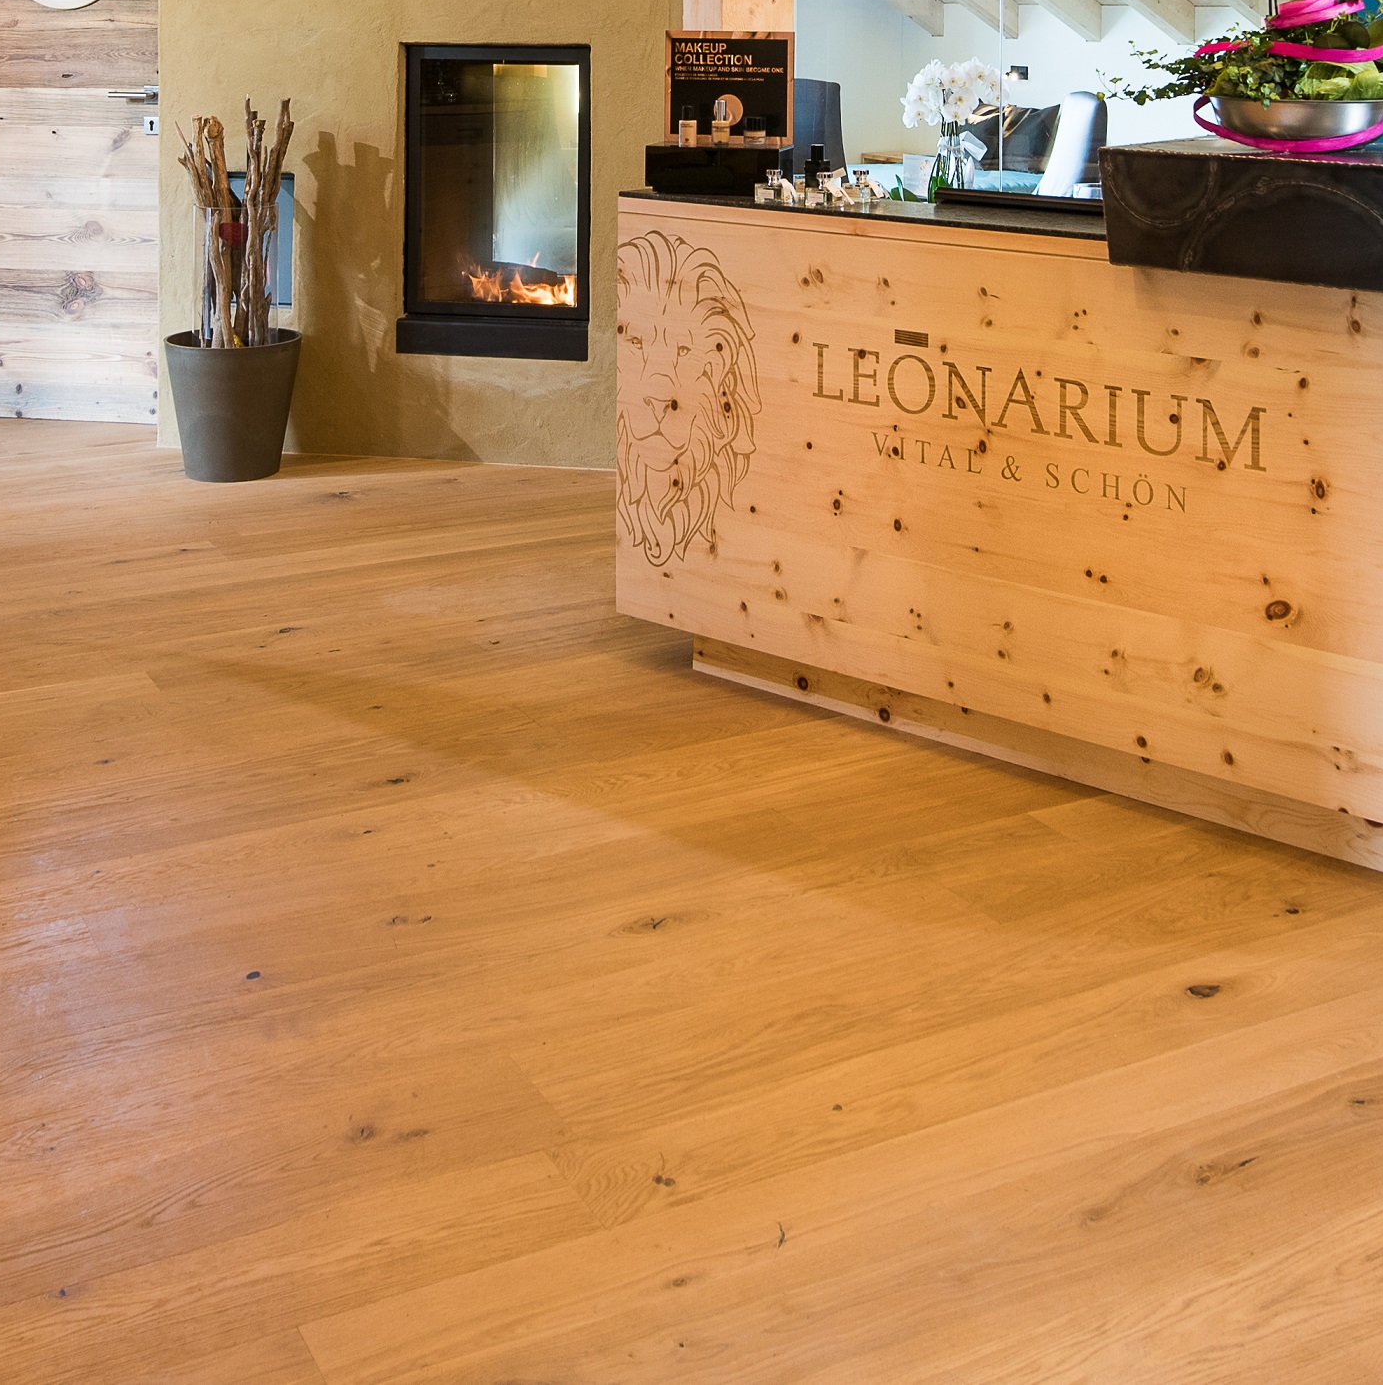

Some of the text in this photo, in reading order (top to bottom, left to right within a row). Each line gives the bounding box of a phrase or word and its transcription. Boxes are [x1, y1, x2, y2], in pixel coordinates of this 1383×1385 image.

[675, 43, 726, 53] MAKEUP
[674, 54, 752, 65] COLLECTION
[870, 432, 1188, 513] VITAL & SCHÖN
